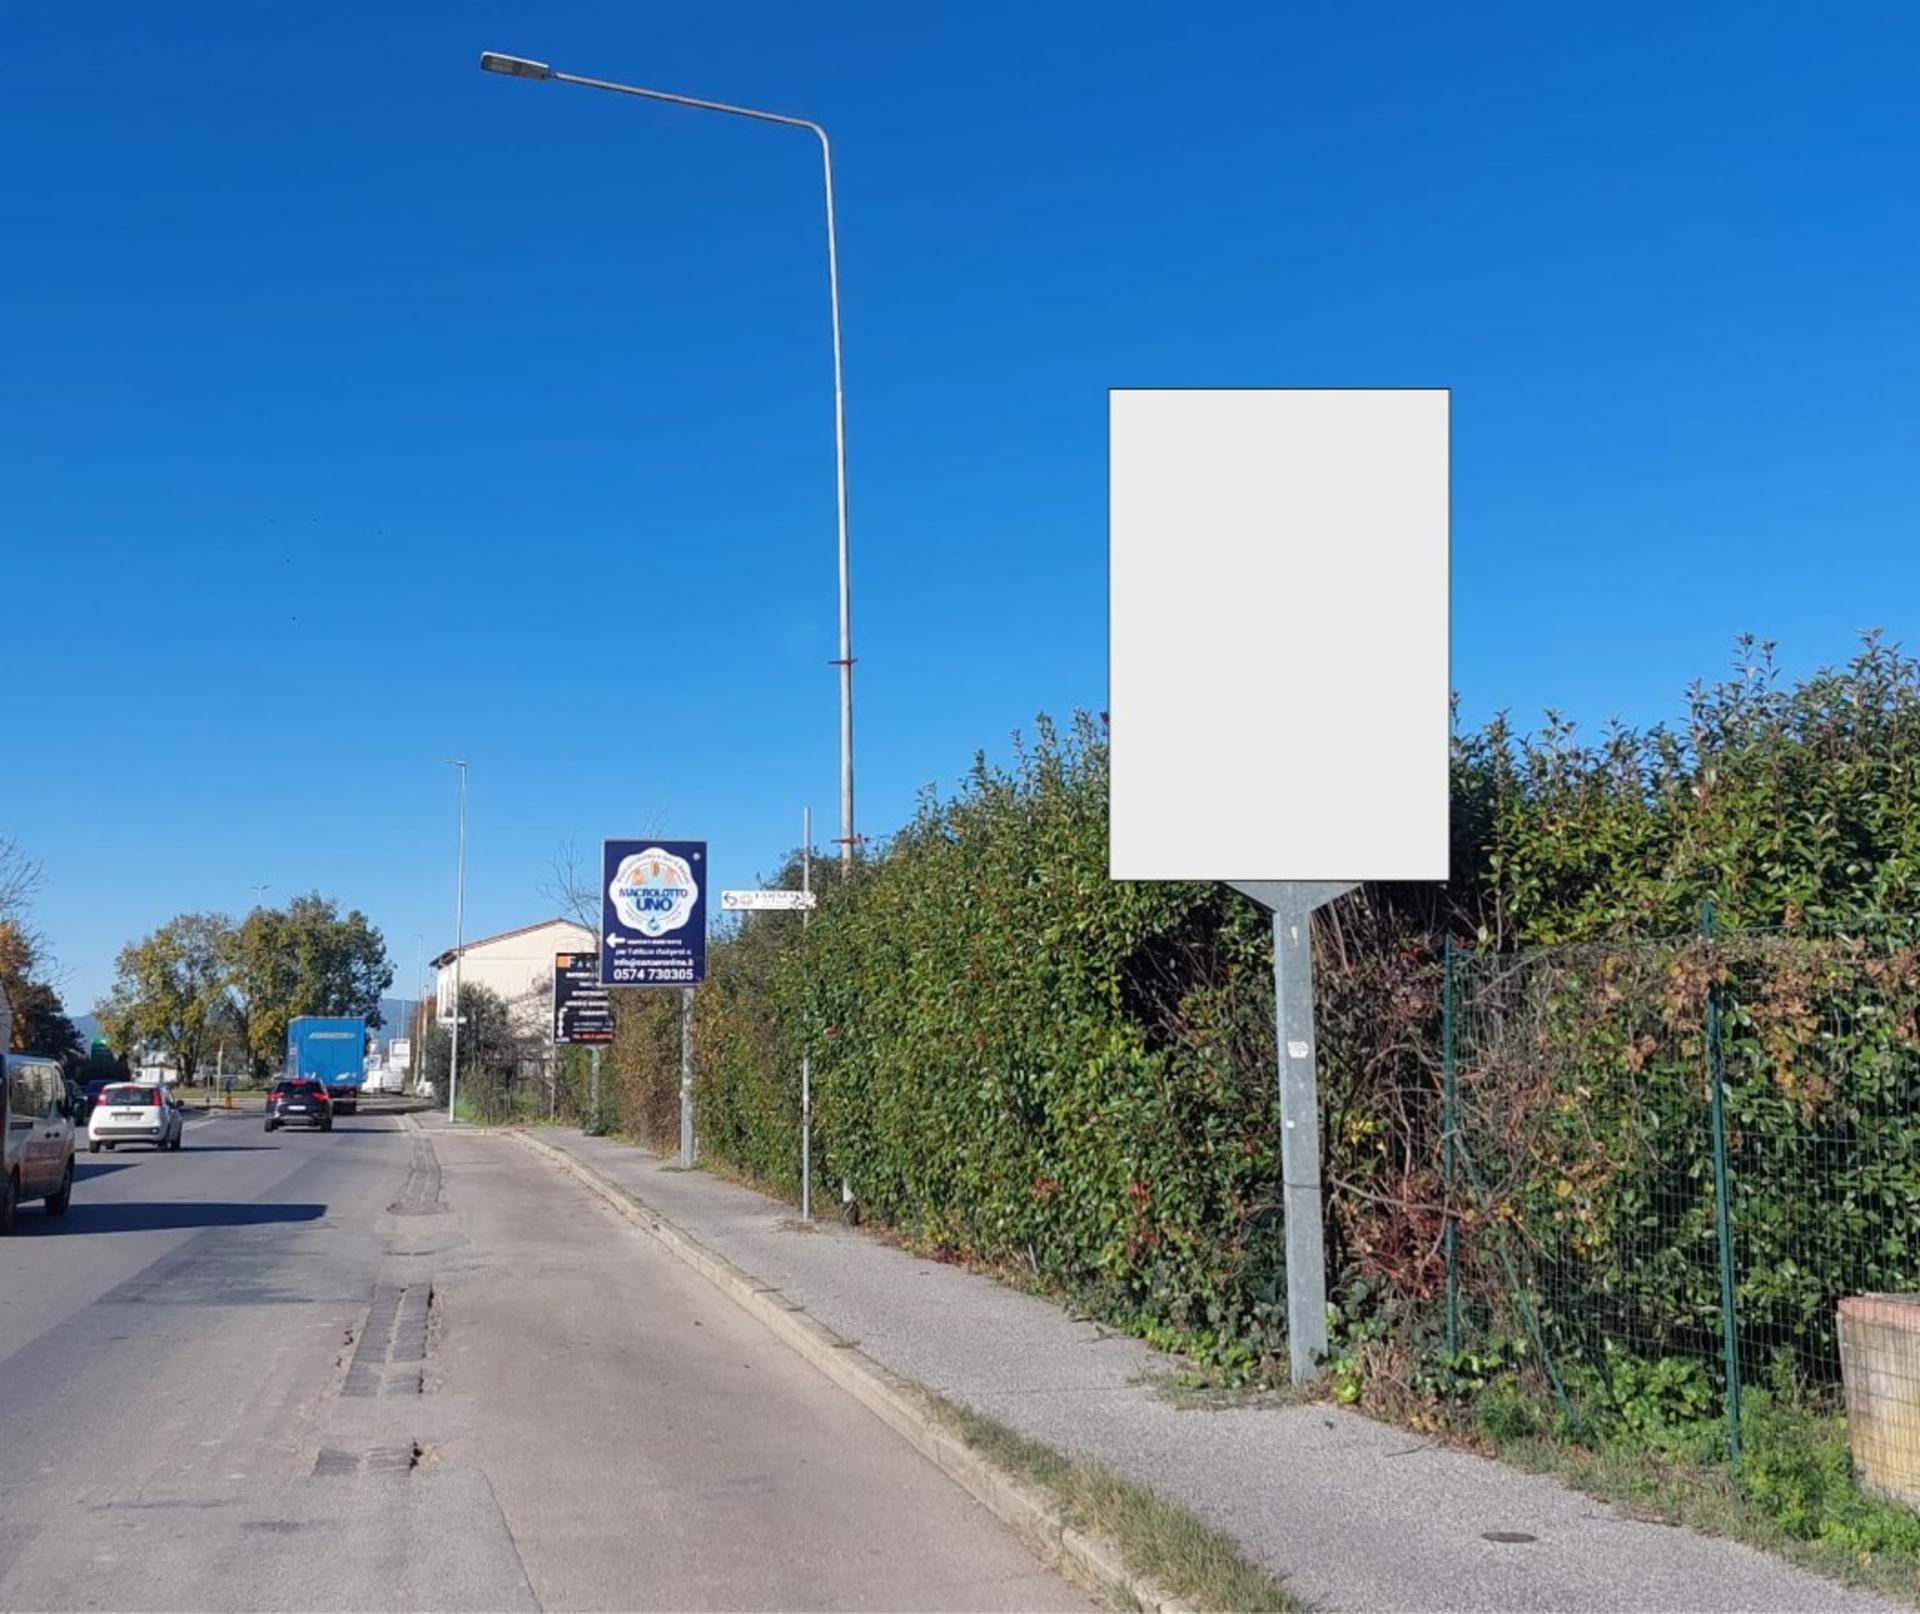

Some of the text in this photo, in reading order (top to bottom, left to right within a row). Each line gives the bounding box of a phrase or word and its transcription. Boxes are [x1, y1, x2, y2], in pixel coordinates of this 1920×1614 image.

[619, 888, 688, 898] MACROLOTTO
[637, 898, 673, 911] UNO
[613, 968, 693, 980] 0574 730305
